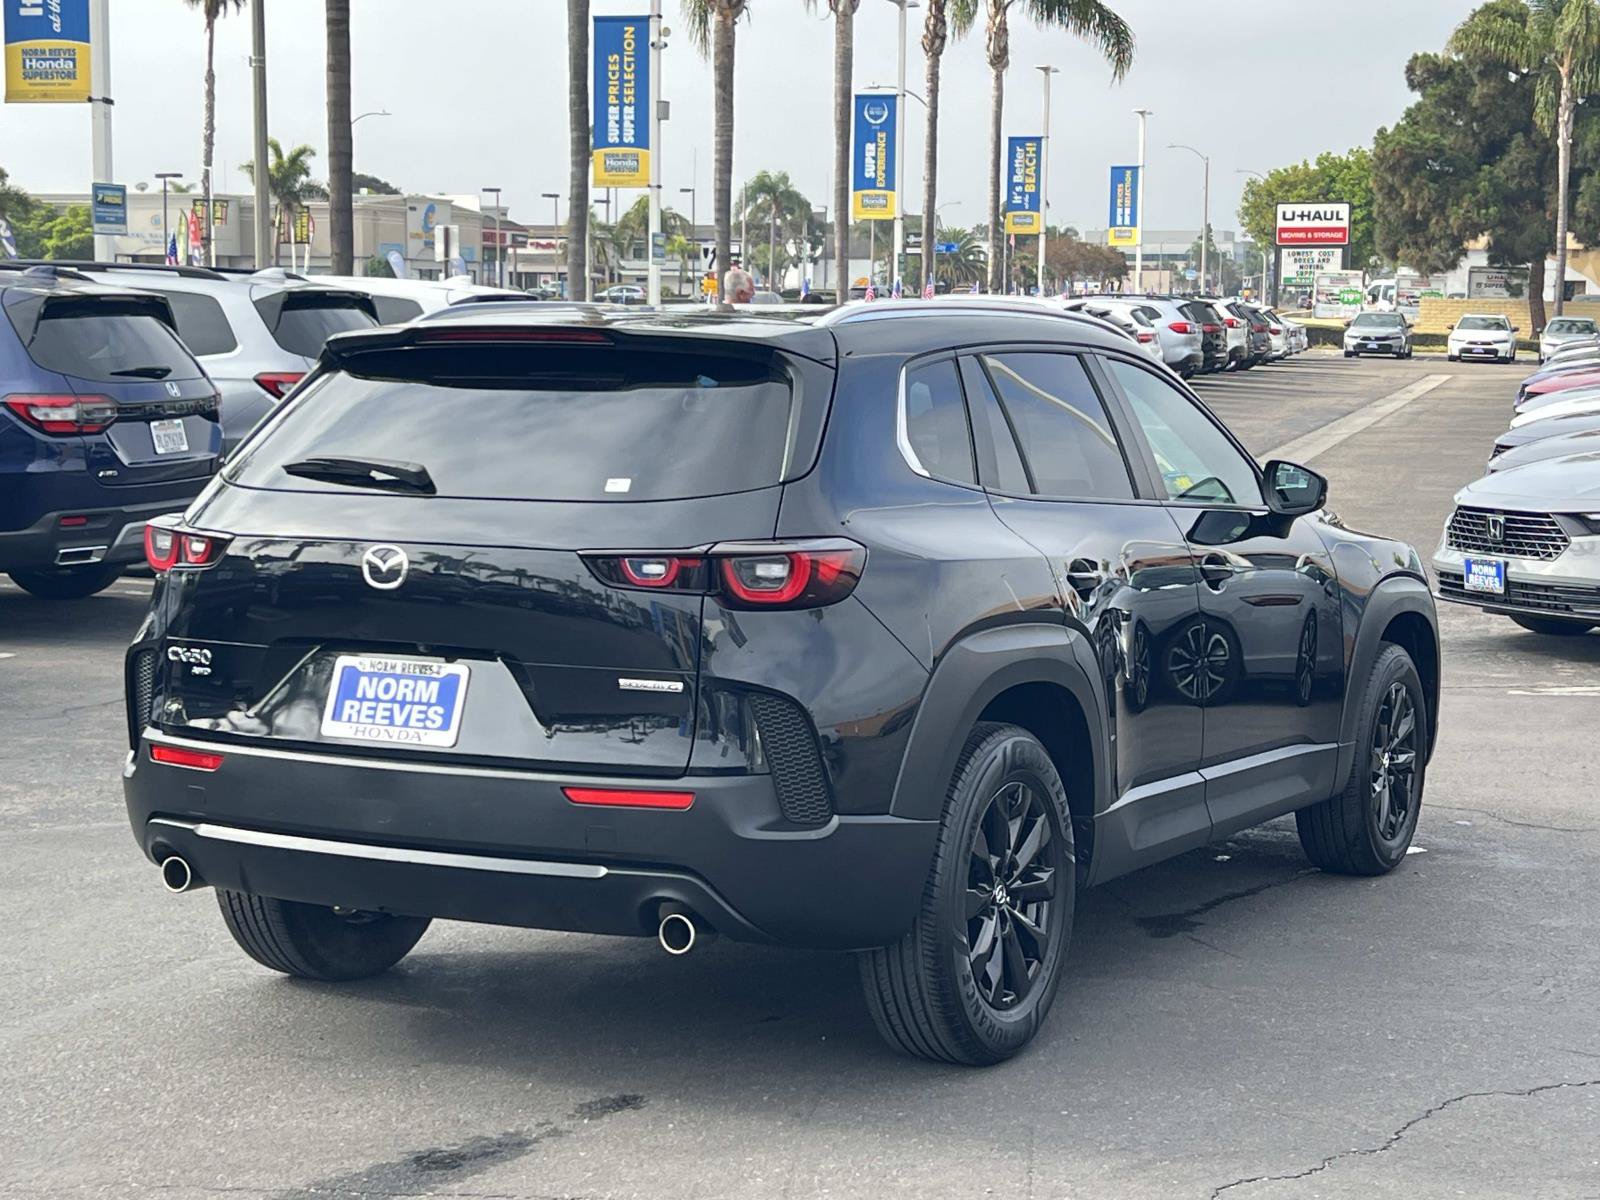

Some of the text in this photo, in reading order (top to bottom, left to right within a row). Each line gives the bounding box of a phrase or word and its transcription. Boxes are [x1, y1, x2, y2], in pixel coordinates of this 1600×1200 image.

[22, 48, 77, 57] NORM REEVES
[25, 58, 74, 69] Honda
[22, 70, 77, 80] SUPERSTORE
[623, 26, 635, 144] SUPER SELECTION
[608, 54, 620, 144] SUPER PRICES
[606, 159, 637, 167] Honda
[865, 142, 876, 179] SUPER
[876, 131, 886, 187] EXPERIENCE
[1013, 146, 1025, 183] Better
[1024, 142, 1037, 192] BEACH!
[1012, 185, 1023, 204] It's
[1282, 210, 1344, 221] U-HAUL
[1468, 572, 1500, 586] REEVES
[1471, 563, 1497, 577] NORM
[370, 660, 434, 674] NORM REEVES
[356, 675, 440, 704] NORM
[341, 699, 445, 729] REEVES
[353, 725, 423, 742] HONDA
